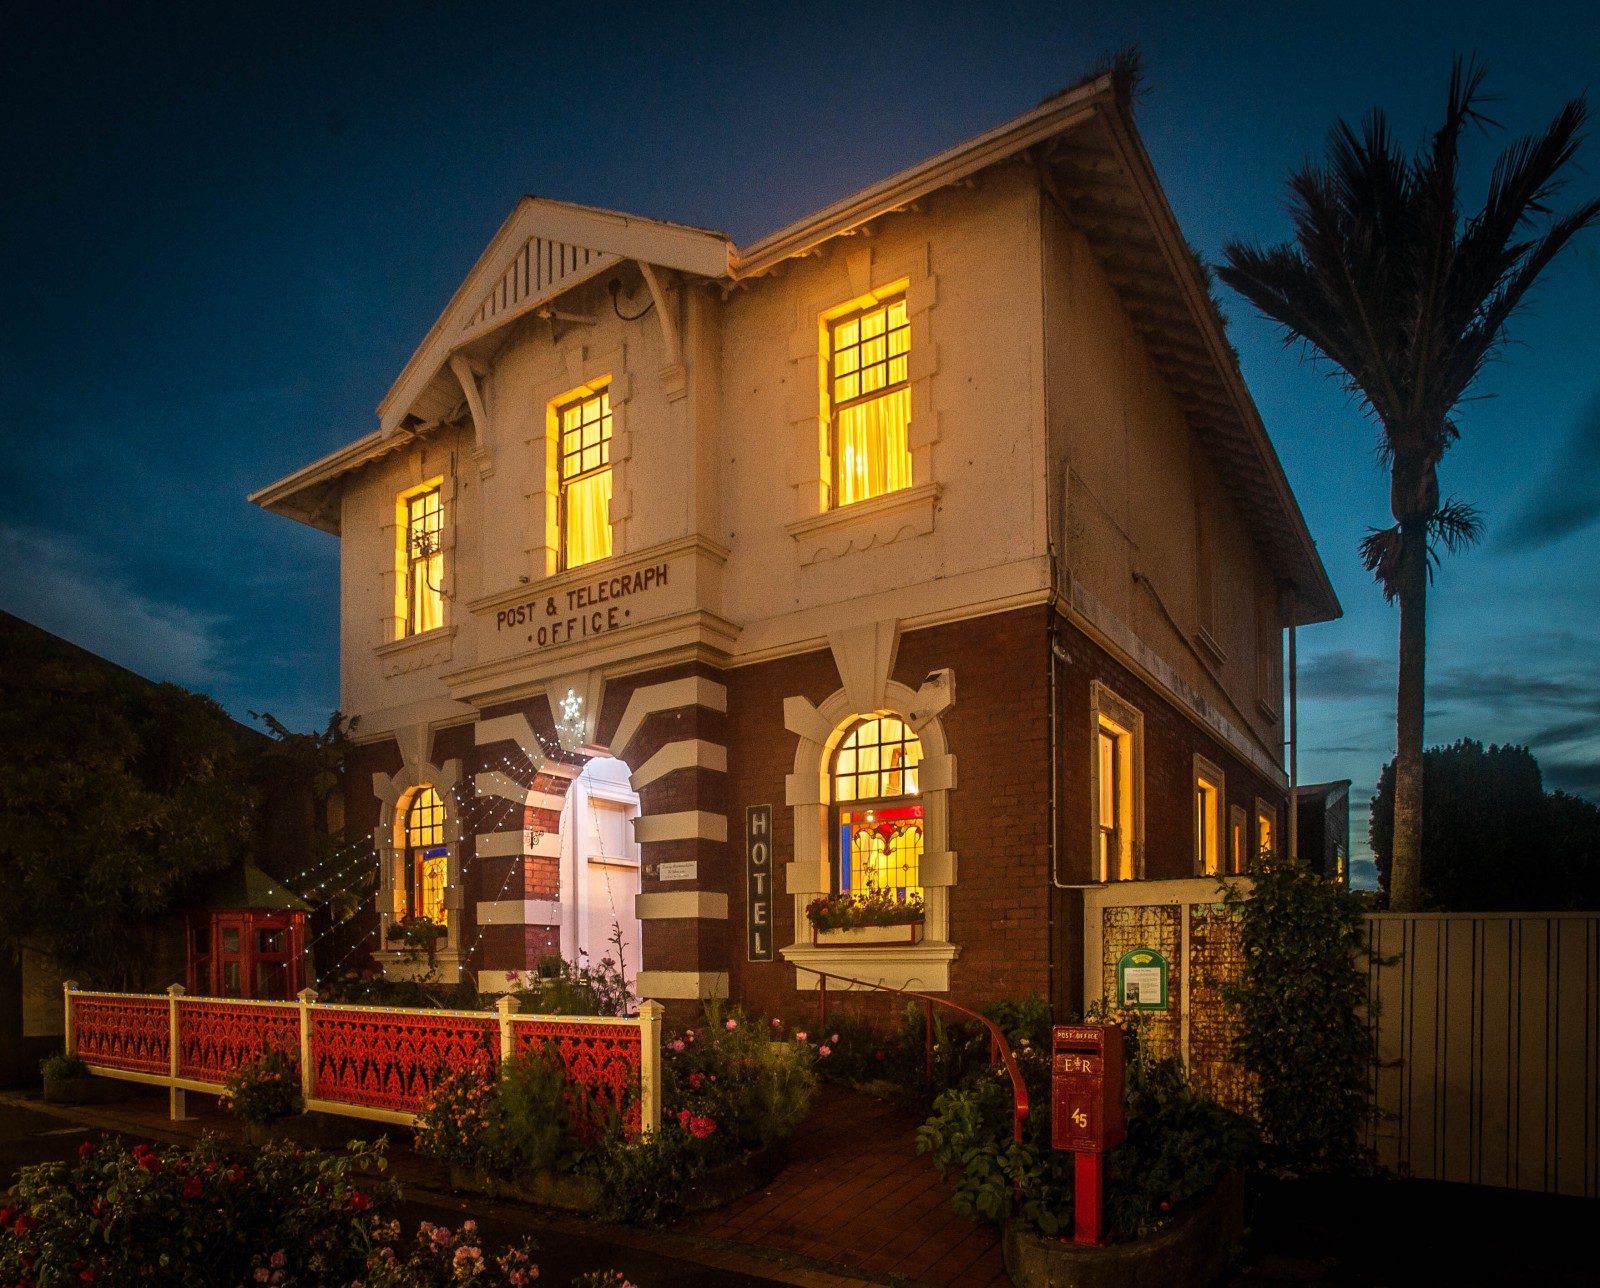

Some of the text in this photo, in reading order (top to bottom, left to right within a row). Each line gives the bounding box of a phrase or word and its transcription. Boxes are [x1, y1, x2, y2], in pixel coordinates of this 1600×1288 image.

[496, 563, 668, 631] POST & TELEGRAPH
[752, 813, 768, 954] HOTEL
[1057, 1031, 1098, 1040] POST OFFICE
[1071, 1107, 1088, 1128] 45
